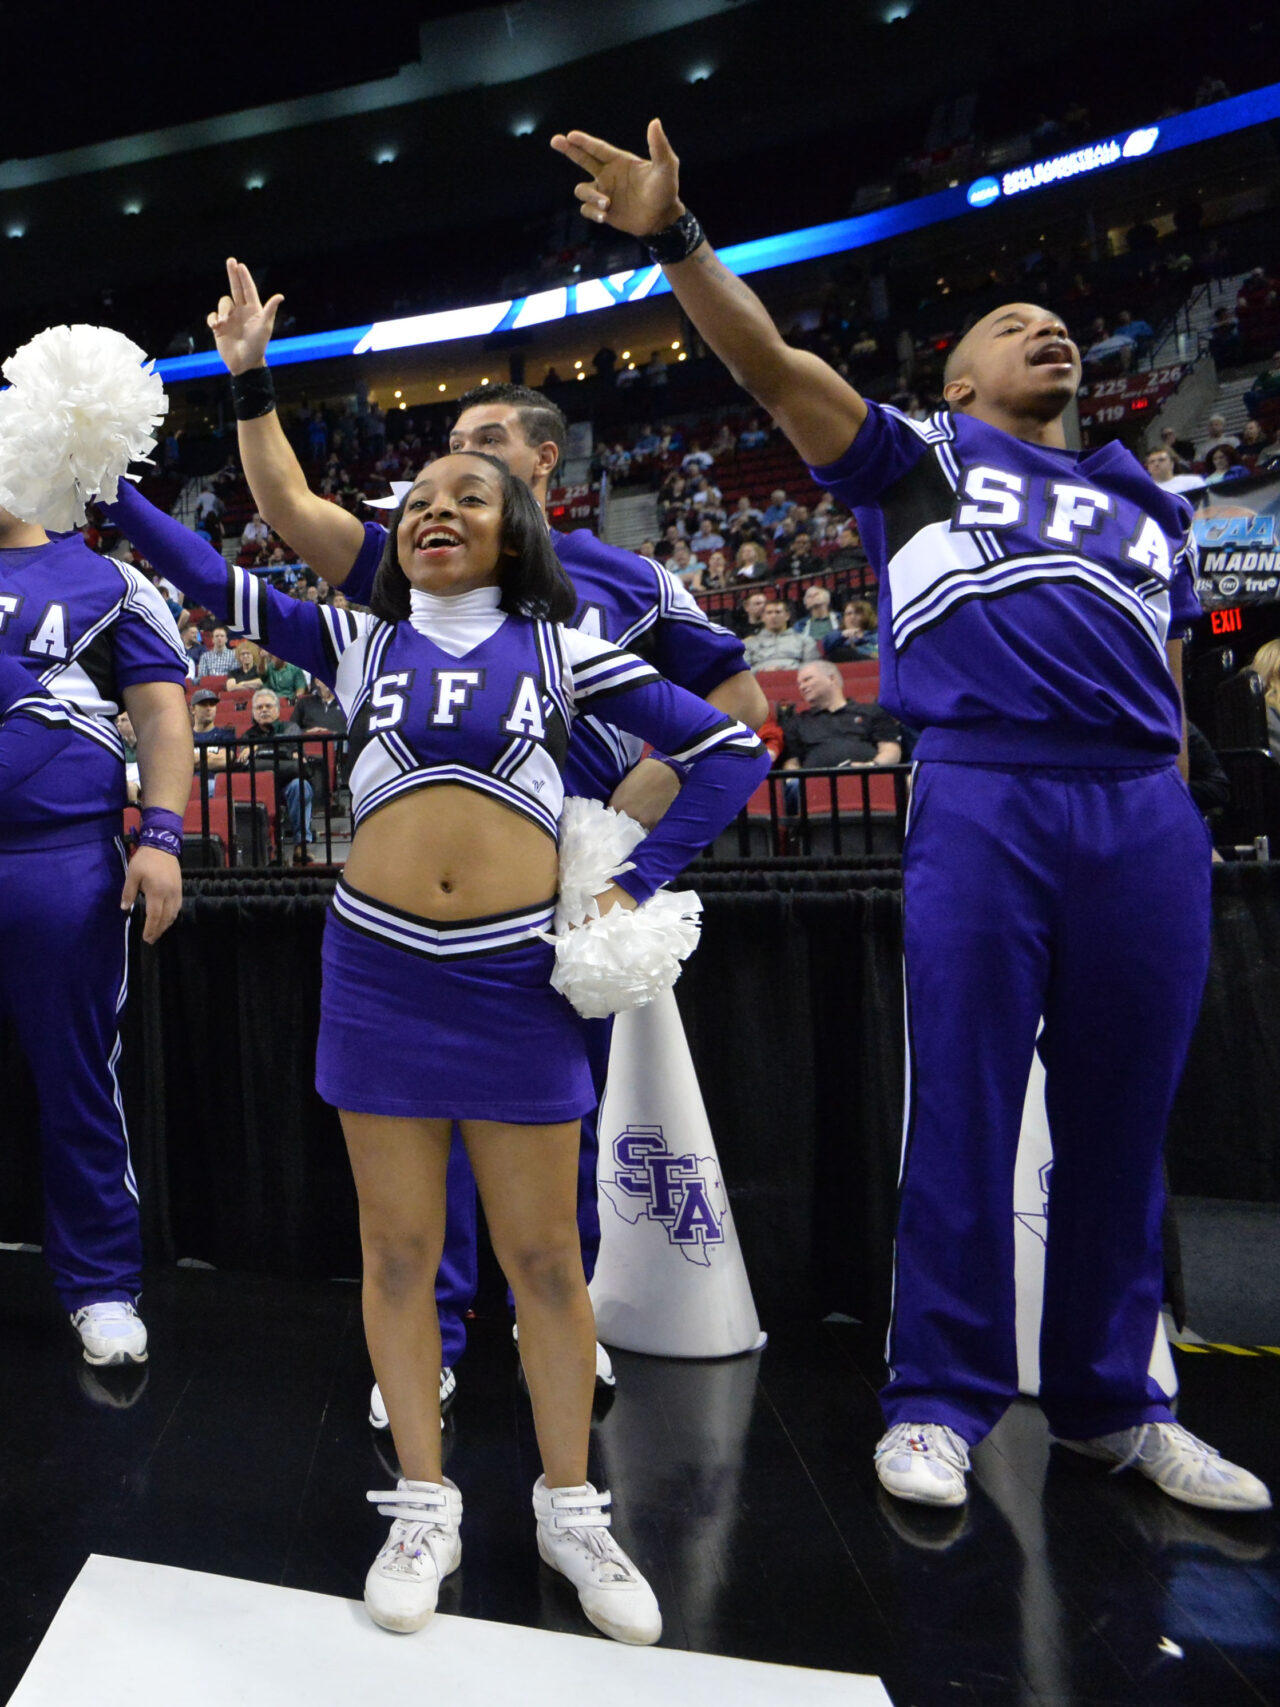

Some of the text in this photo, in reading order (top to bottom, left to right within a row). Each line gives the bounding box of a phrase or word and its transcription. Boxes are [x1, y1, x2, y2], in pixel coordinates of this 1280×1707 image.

[1094, 379, 1128, 398] 225
[1147, 367, 1181, 387] 226
[1095, 406, 1125, 422] 119
[1196, 579, 1213, 591] BS
[1210, 608, 1242, 634] EXIT
[368, 670, 547, 740] SFA
[612, 1131, 725, 1245] SFA
